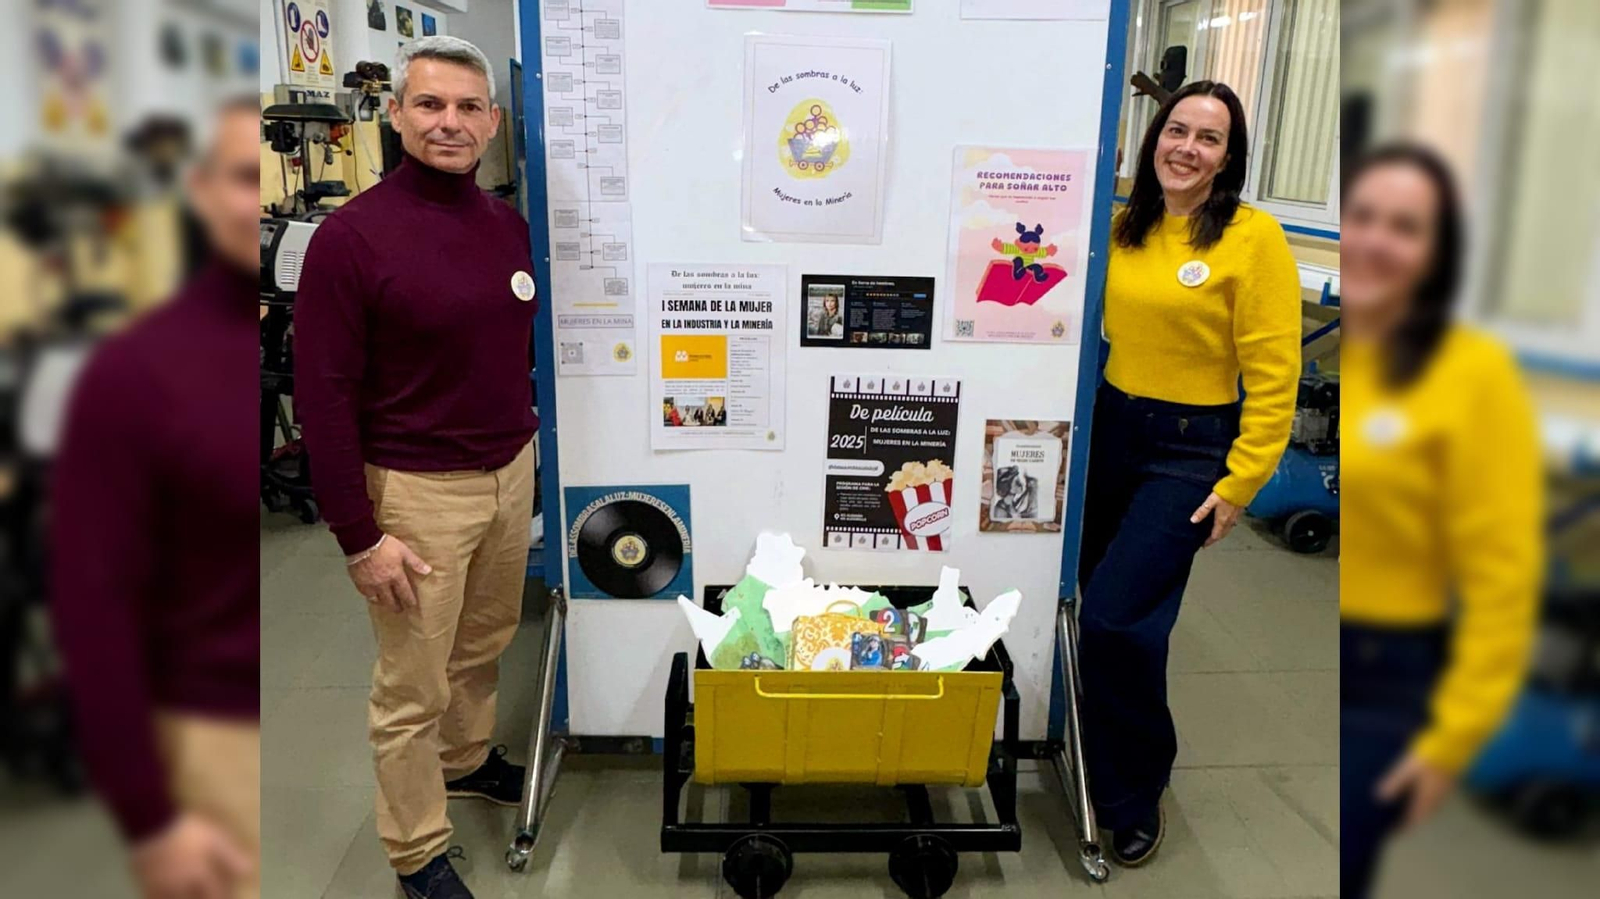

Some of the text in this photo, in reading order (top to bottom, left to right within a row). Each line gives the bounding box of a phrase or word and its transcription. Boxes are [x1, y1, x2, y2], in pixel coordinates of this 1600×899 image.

[768, 82, 780, 93] De
[780, 75, 793, 84] las
[796, 70, 829, 79] sombras
[841, 75, 848, 84] la
[850, 80, 863, 94] luz:
[977, 171, 1072, 182] RECOMENDACIONES
[979, 181, 1067, 192] PARA SOÑAR ALTO
[773, 187, 801, 204] Mujeres
[671, 270, 681, 278] De
[683, 270, 694, 278] las
[697, 270, 729, 278] sombras
[724, 282, 731, 290] la
[661, 300, 772, 313] I SEMANA DE LA MUJER
[661, 319, 773, 330] EN LA INDUSTRIA Y LA MINERÍA
[850, 404, 935, 423] De película
[830, 434, 865, 449] 2025
[1011, 450, 1045, 459] MUJERES
[909, 507, 949, 532] POPCORN
[883, 610, 896, 633] 2
